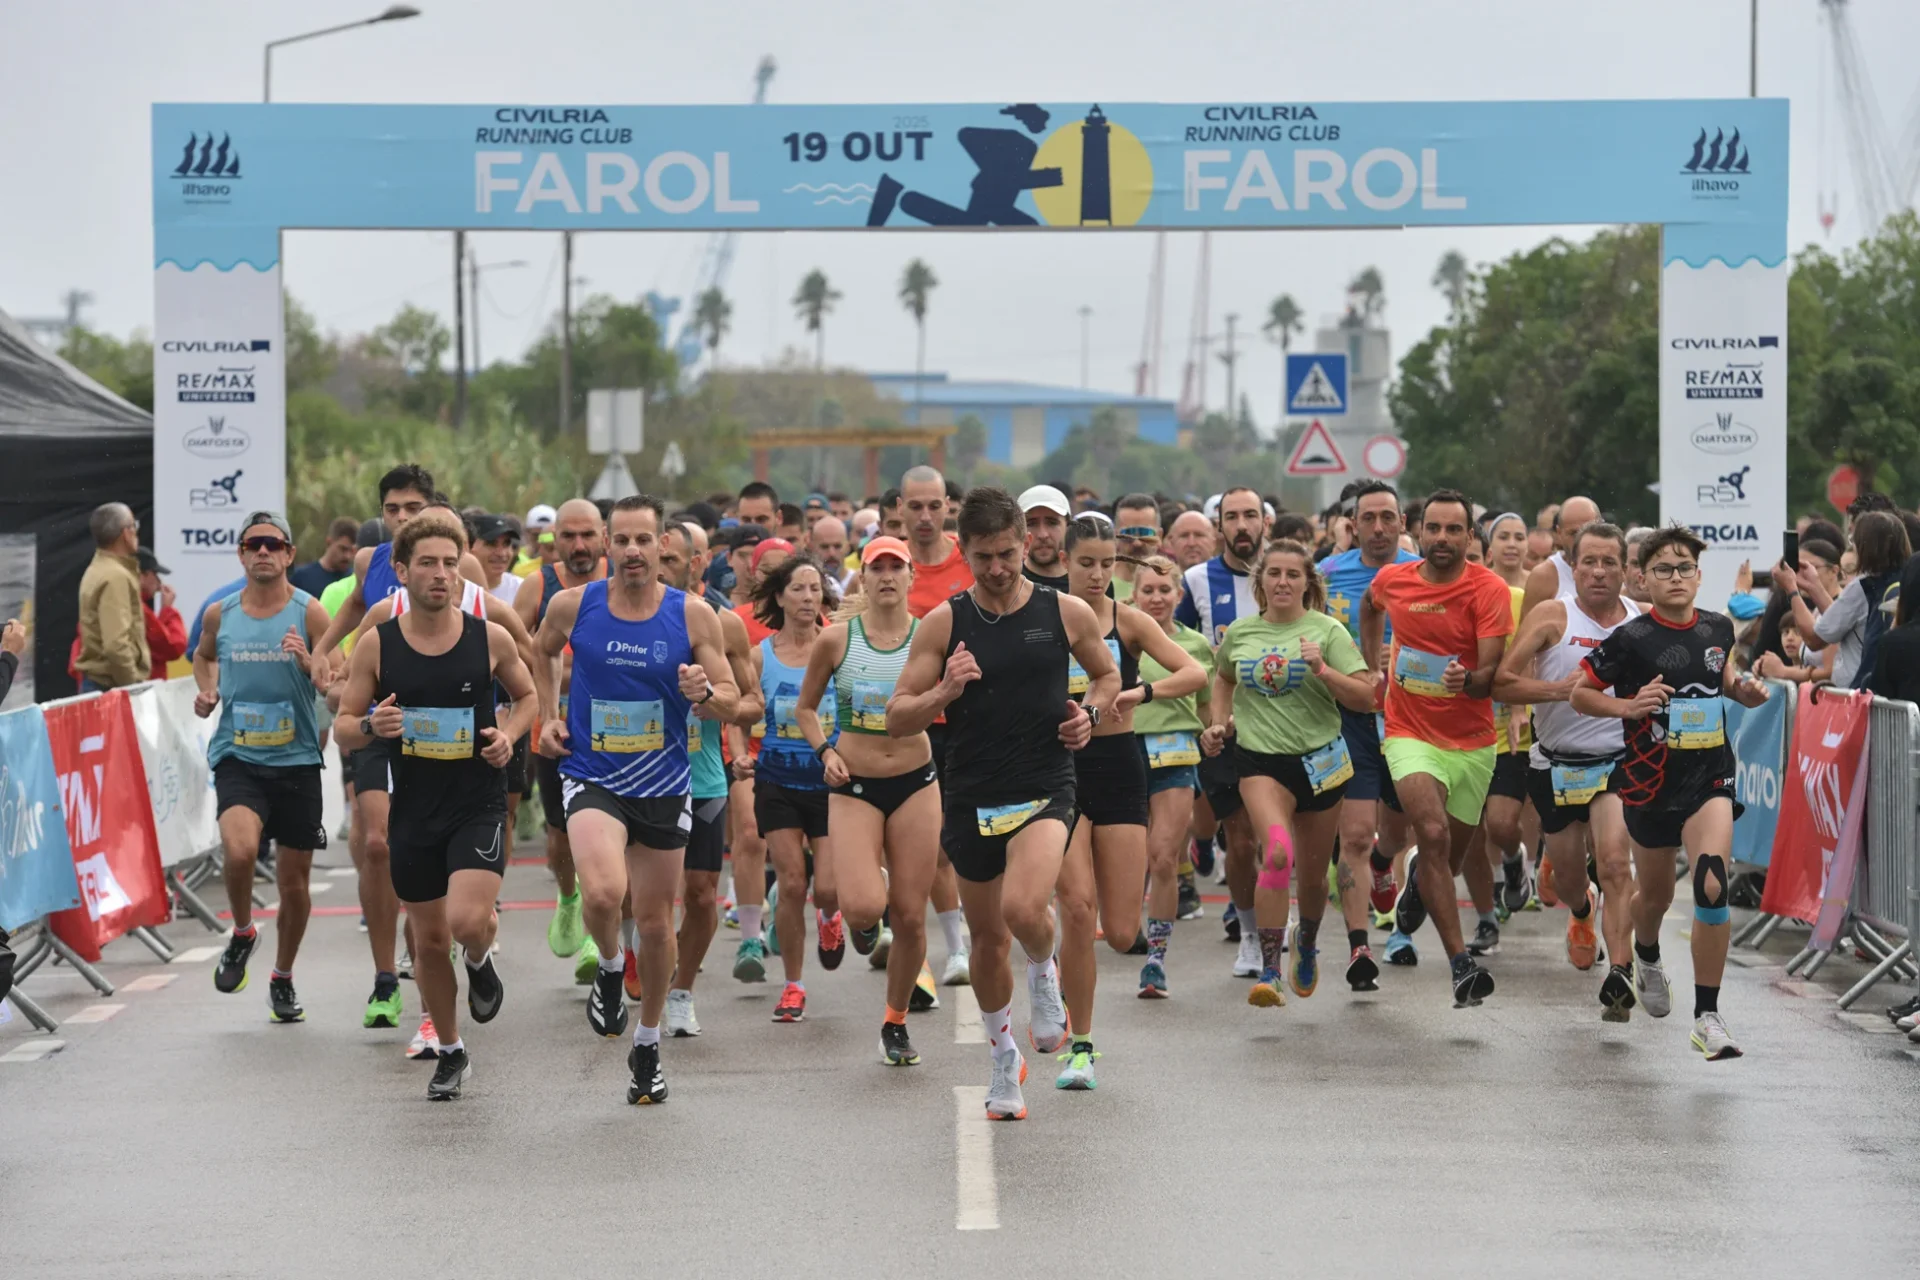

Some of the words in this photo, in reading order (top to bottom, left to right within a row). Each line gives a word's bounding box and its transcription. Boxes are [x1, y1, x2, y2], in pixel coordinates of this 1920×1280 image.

[495, 108, 609, 124] CIVILRIA
[1204, 106, 1318, 121] CIVILRIA
[893, 115, 930, 129] 2025
[475, 128, 573, 144] RUNNING
[580, 128, 633, 144] CLUB
[1185, 126, 1282, 142] RUNNING
[1288, 125, 1340, 141] CLUB
[783, 131, 828, 162] 19
[842, 131, 933, 162] OUT
[475, 150, 760, 214] FAROL
[1184, 147, 1466, 211] FAROL
[1691, 179, 1739, 192] ilhavo
[182, 183, 231, 196] ilhavo
[162, 340, 250, 352] CIVILRIA
[1671, 338, 1759, 350] CIVILRIA
[177, 373, 256, 388] RE/MAX
[1686, 370, 1763, 385] RE/MAX
[181, 391, 250, 402] UNIVERSAL
[1690, 388, 1759, 399] UNIVERSAL
[592, 705, 622, 714] FAROL
[604, 713, 629, 728] 611
